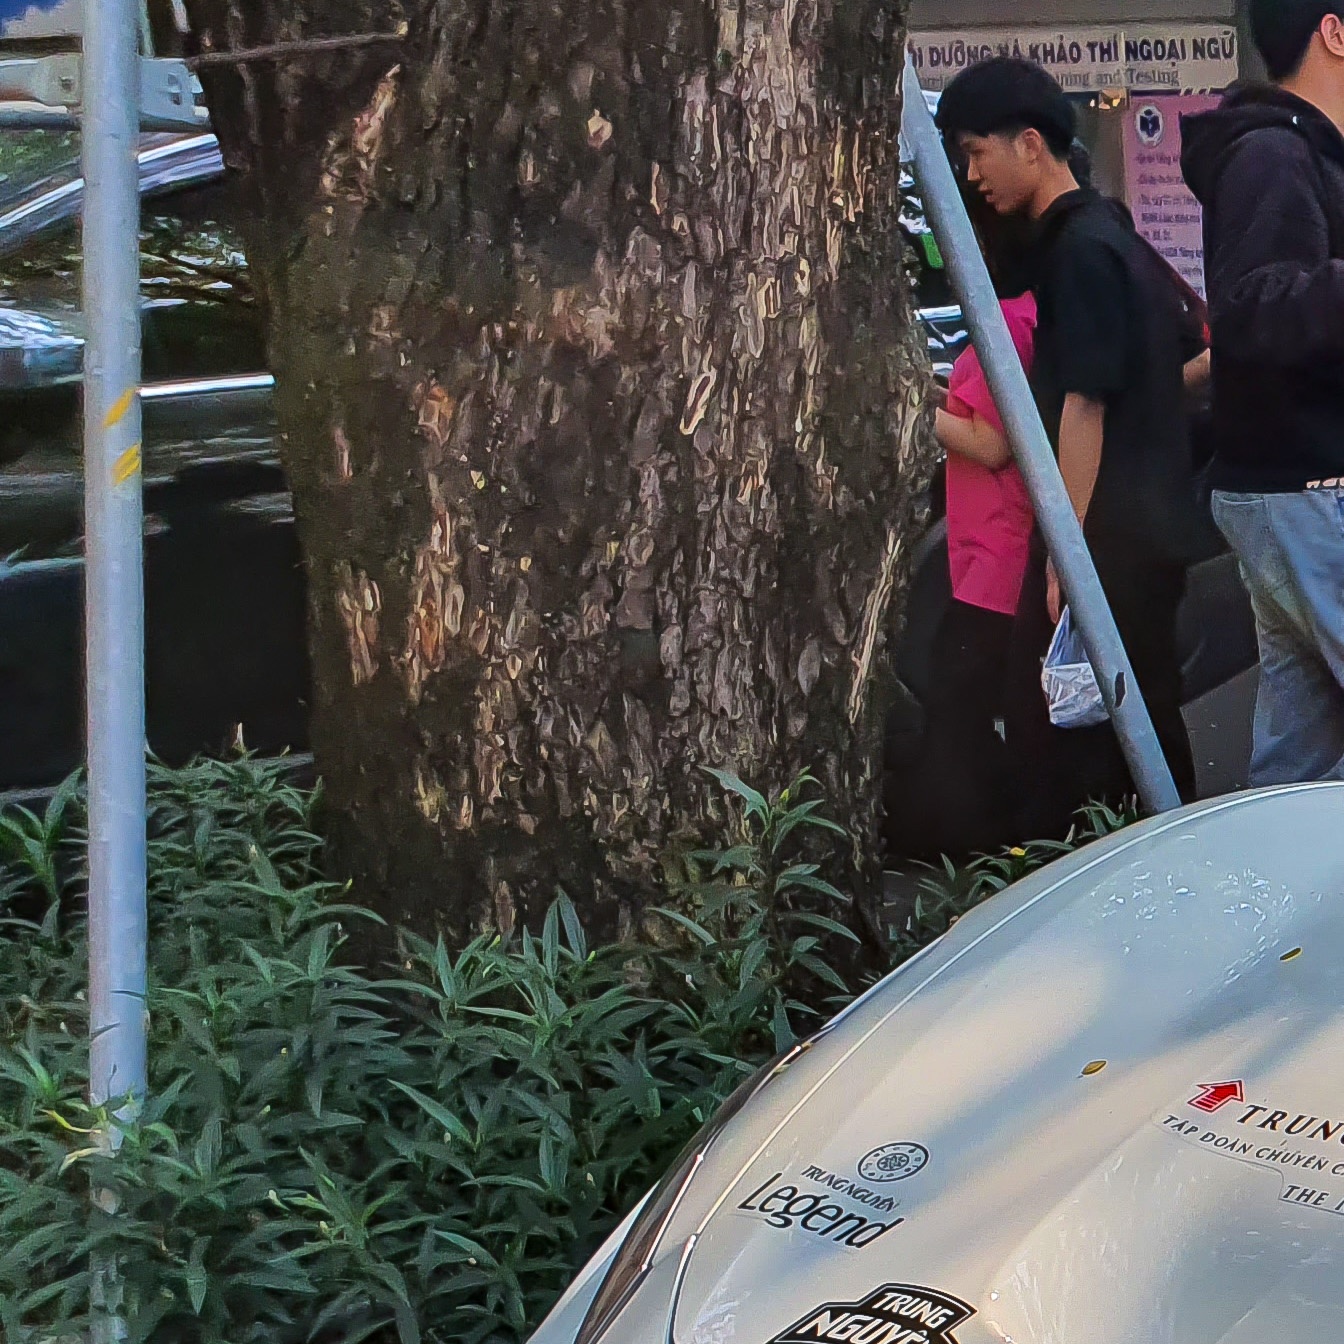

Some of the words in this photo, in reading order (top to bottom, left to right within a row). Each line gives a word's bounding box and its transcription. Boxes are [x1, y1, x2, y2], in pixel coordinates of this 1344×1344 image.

[1029, 34, 1081, 66] KHẢO
[1087, 33, 1119, 62] THÍ
[1125, 37, 1187, 67] NGOẠI
[1193, 30, 1236, 60] NGỮ
[1163, 1114, 1199, 1135] TẬP
[1199, 1131, 1253, 1155] ĐOÀN
[737, 1172, 905, 1249] Legend
[1282, 1184, 1330, 1207] THE
[872, 1291, 954, 1330] TRUNG
